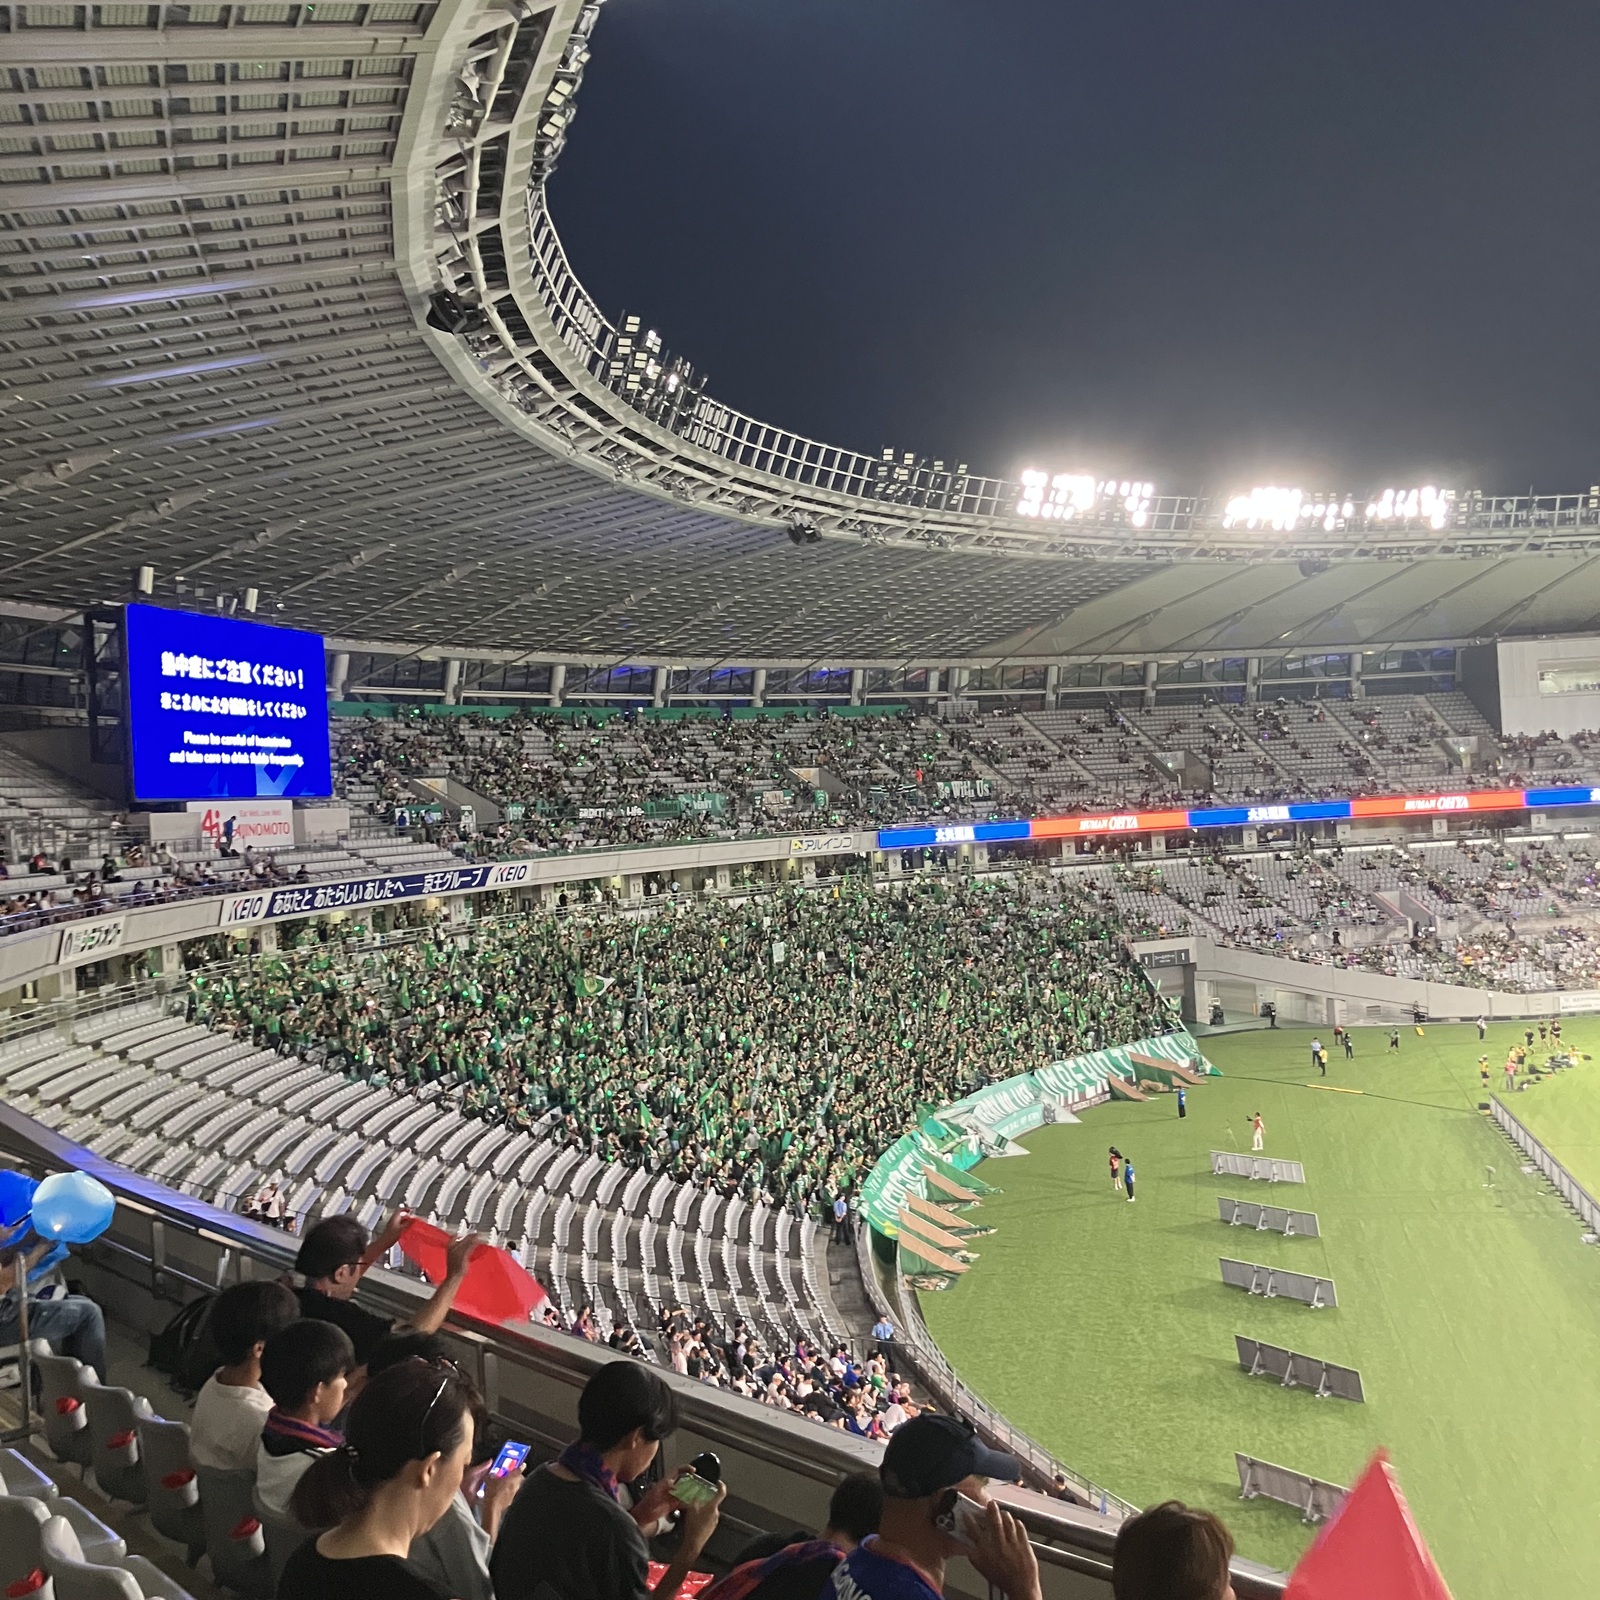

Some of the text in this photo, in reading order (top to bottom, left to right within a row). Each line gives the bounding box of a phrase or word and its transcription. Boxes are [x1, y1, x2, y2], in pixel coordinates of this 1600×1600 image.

[976, 779, 990, 798] Us
[804, 836, 853, 851] アルインコ
[494, 865, 528, 883] KEIO
[228, 896, 263, 921] KEIO
[273, 889, 312, 914] あなたと
